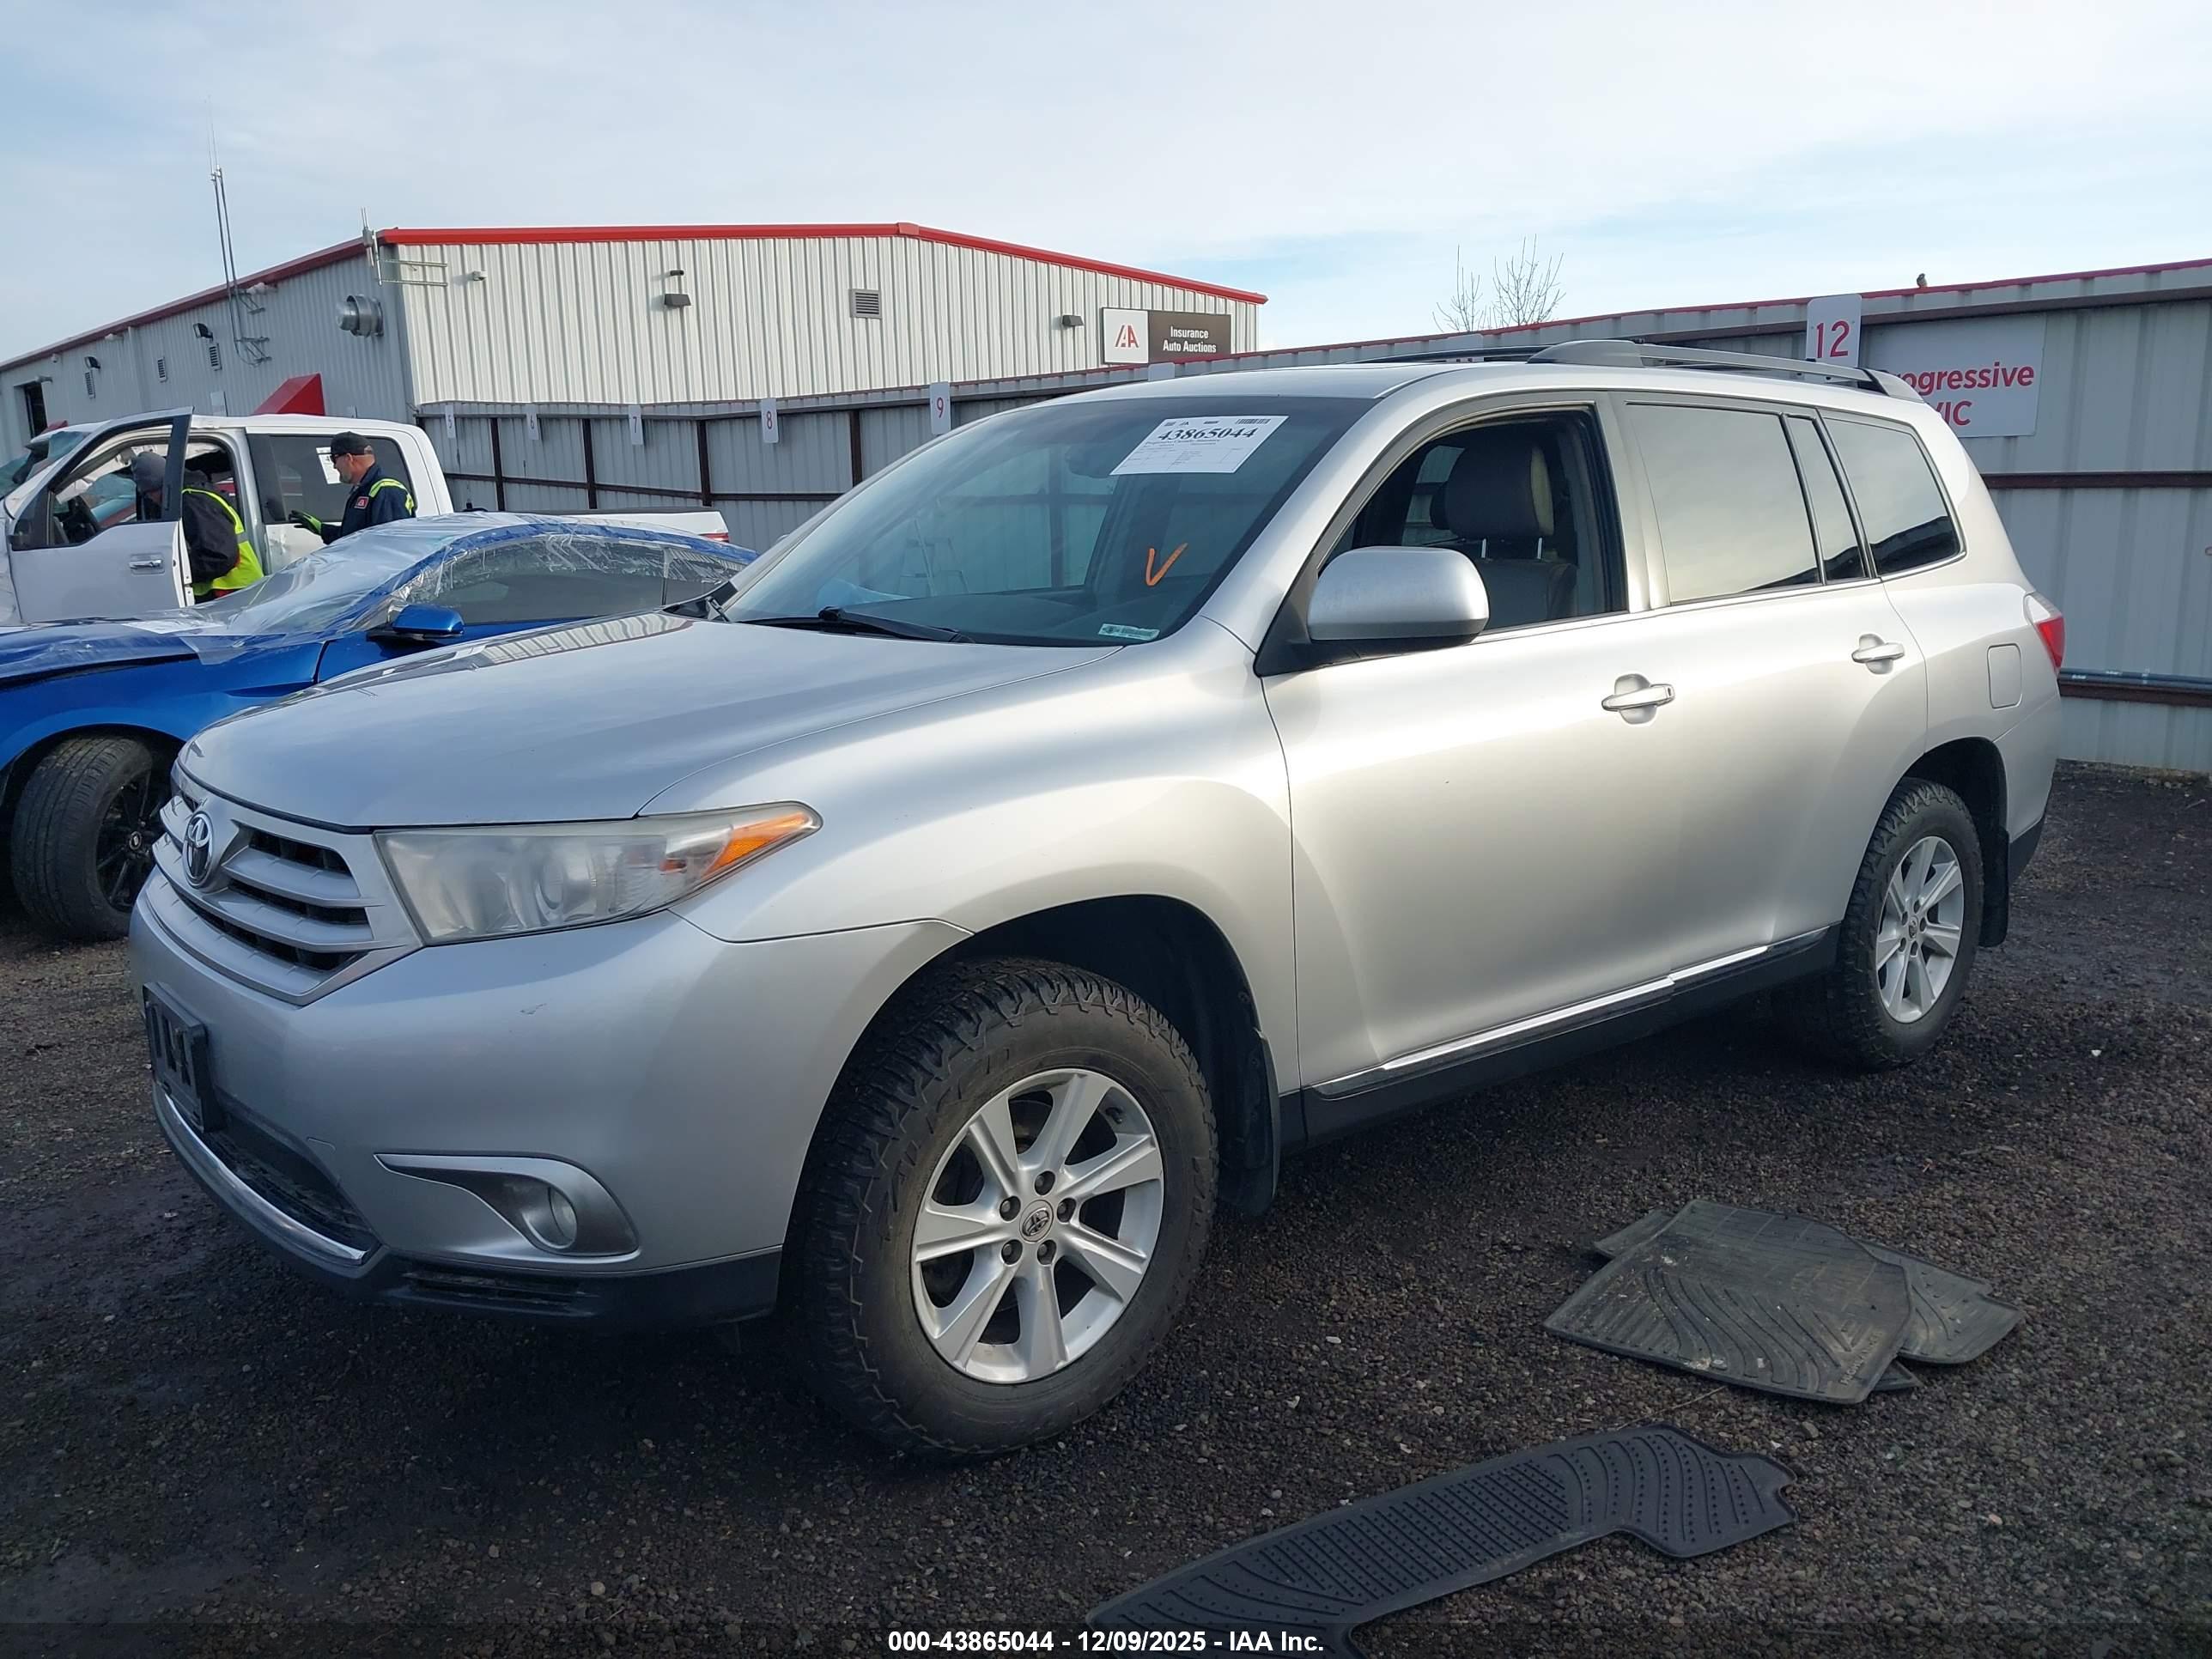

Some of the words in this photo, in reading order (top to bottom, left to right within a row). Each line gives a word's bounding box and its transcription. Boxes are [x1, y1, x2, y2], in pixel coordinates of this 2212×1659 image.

[1170, 326, 1209, 339] Insurance
[1815, 320, 1850, 358] 12
[1163, 339, 1182, 352] Auto
[1182, 340, 1217, 354] Auctions
[1895, 362, 2034, 396] ogressive
[936, 396, 945, 419] 9
[631, 416, 638, 434] 7
[766, 410, 773, 429] 8
[1158, 427, 1257, 441] 43865044
